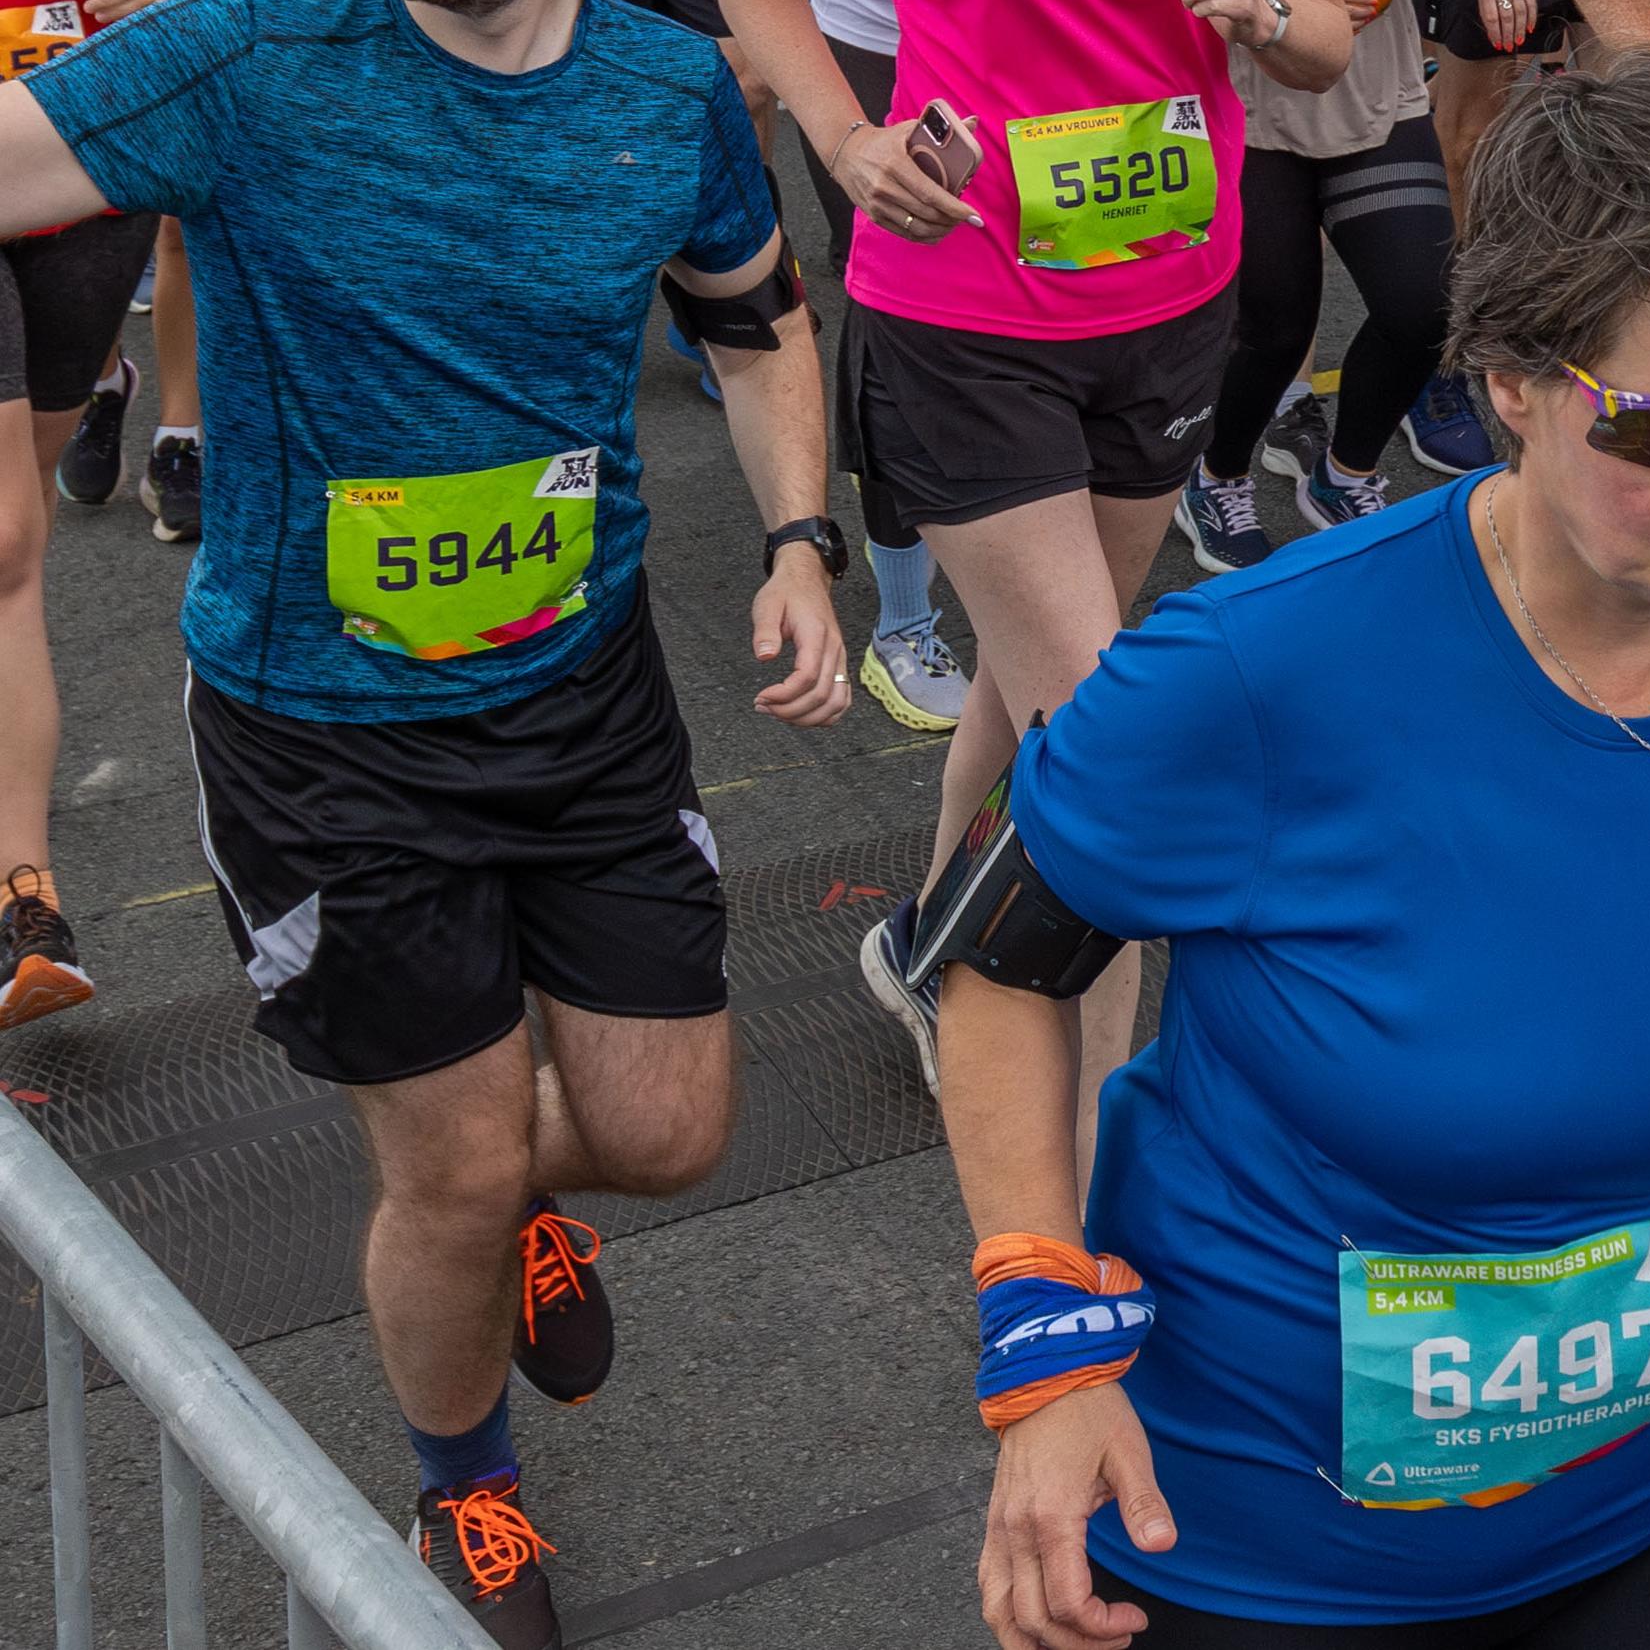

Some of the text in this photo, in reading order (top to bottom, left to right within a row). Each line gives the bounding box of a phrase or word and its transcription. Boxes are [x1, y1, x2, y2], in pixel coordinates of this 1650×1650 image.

[1025, 116, 1120, 139] 5,4 KM VROUWEN
[1171, 120, 1201, 130] RUN
[1050, 146, 1190, 210] 5520
[1102, 205, 1149, 221] HENRIET
[545, 475, 591, 494] RUN
[376, 490, 399, 502] KM
[376, 511, 562, 592] 5944
[1373, 1238, 1629, 1282] ULTRAWARE BUSINESS RUN
[1374, 1289, 1445, 1312] 5,4 KM
[1434, 1427, 1482, 1447] SKS
[1403, 1460, 1481, 1480] Ultraware
